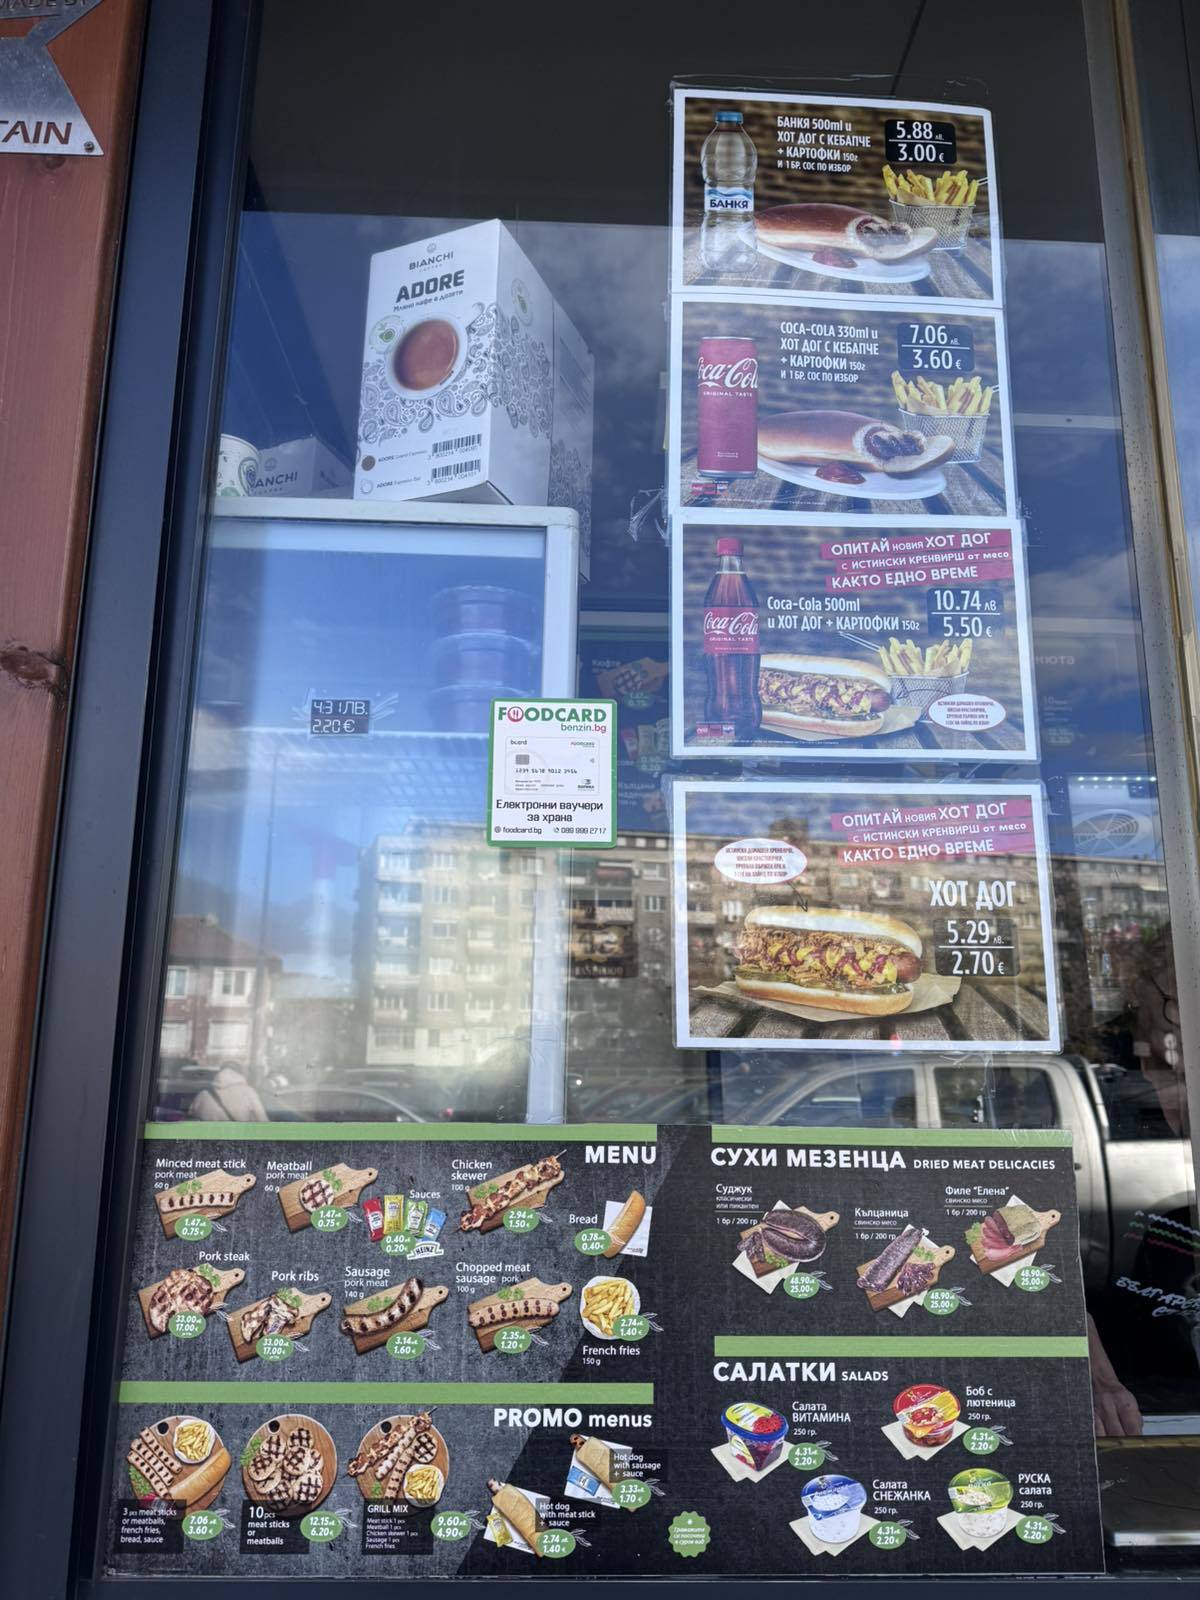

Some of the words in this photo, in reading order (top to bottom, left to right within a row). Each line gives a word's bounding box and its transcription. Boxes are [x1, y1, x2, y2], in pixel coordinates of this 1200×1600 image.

[777, 116, 810, 129] БАНКЯ
[812, 118, 843, 131] 500ml
[0, 121, 73, 146] AIN
[896, 121, 933, 140] 5.88
[777, 131, 796, 143] ХОТ
[798, 132, 817, 146] ДОГ
[819, 133, 826, 145] С
[827, 134, 871, 148] КЕБАПЧЕ
[786, 147, 841, 161] КАРТОФКИ
[898, 143, 937, 162] 3.00
[803, 161, 816, 171] СОС
[817, 162, 827, 172] ПО
[828, 163, 852, 173] ИЗБОР
[710, 199, 749, 209] БАНКЯ
[408, 251, 454, 271] BIANCHI
[396, 269, 465, 304] ADORE
[780, 322, 836, 338] COCA-COLA
[837, 325, 869, 339] 330ml
[910, 324, 948, 345] 7.06
[780, 338, 799, 351] ХОТ
[802, 339, 822, 353] ДОГ
[824, 340, 831, 353] С
[832, 341, 880, 356] КЕБАПЧЕ
[790, 355, 847, 371] КАРТОФКИ
[912, 349, 953, 370] 3.60
[955, 359, 963, 371] €
[807, 371, 821, 381] СОС
[822, 372, 833, 382] ПО
[834, 373, 859, 384] ИЗБОР
[831, 538, 890, 557] ОПИТАЙ
[925, 535, 955, 550] ХОТ
[961, 532, 991, 548] ДОГ
[852, 557, 907, 570] ИСТИНСКИ
[908, 552, 965, 567] КРЕНВИРШ
[832, 572, 881, 589] КАКТО
[886, 567, 927, 587] ЕДНО
[930, 564, 979, 582] ВРЕМЕ
[767, 596, 823, 611] Coca-Cola
[825, 597, 861, 612] 500ml
[934, 590, 982, 611] 10.74
[704, 611, 760, 636] Coca-Cola
[778, 615, 799, 630] ХОТ
[801, 616, 824, 632] ДОГ
[836, 615, 900, 632] КАРТОФКИ
[943, 616, 983, 638] 5.50
[986, 626, 993, 638] €
[498, 706, 607, 723] FOODCARD
[560, 723, 607, 734] benzin.bg
[496, 798, 558, 812] Електронни
[560, 800, 604, 813] ваучери
[527, 814, 540, 823] за
[542, 814, 573, 826] храна
[842, 808, 903, 828] ОПИТАЙ
[938, 806, 970, 821] ХОТ
[976, 802, 1007, 819] ДОГ
[502, 826, 543, 836] foodcard.bg
[864, 830, 920, 843] ИСТИНСКИ
[922, 824, 980, 839] КРЕНВИРШ
[843, 846, 894, 863] КАКТО
[898, 844, 941, 861] ЕДНО
[946, 840, 995, 856] ВРЕМЕ
[928, 880, 969, 907] ХОТ
[976, 880, 1017, 911] ДОГ
[947, 920, 990, 945] 5.29
[952, 950, 995, 976] 2.70
[997, 961, 1005, 975] €
[585, 1145, 657, 1165] MENU
[710, 1147, 778, 1168] СУХИ
[786, 1148, 907, 1173] МЕЗЕНЦА
[156, 1158, 193, 1169] Minced
[195, 1160, 222, 1170] meat
[223, 1159, 247, 1170] stick
[266, 1161, 313, 1172] Meatball
[452, 1159, 493, 1170] Chicken
[913, 1159, 950, 1170] DRIED
[952, 1159, 986, 1170] MEAT
[988, 1160, 1057, 1171] DELICACIES
[154, 1172, 174, 1181] pork
[266, 1172, 288, 1181] pork
[451, 1170, 488, 1181] skewer
[409, 1189, 441, 1199] Sauces
[716, 1184, 753, 1196] Суджук
[945, 1186, 972, 1197] Филе
[854, 1208, 909, 1221] Кълцаница
[966, 1208, 979, 1218] 200
[569, 1214, 599, 1225] Bread
[386, 1234, 405, 1244] 0.40
[876, 1232, 889, 1241] 200
[199, 1251, 223, 1262] Pork
[224, 1251, 251, 1262] steak
[344, 1266, 391, 1280] Sausage
[456, 1262, 503, 1275] Chopped
[504, 1263, 532, 1273] meat
[272, 1270, 297, 1282] Pork
[298, 1270, 320, 1283] ribs
[456, 1274, 497, 1286] sausage
[501, 1274, 520, 1285] pork
[344, 1278, 366, 1289] pork
[366, 1278, 390, 1288] meat
[344, 1291, 358, 1299] 140
[394, 1346, 412, 1355] 1.60
[582, 1345, 617, 1356] French
[618, 1345, 641, 1356] fries
[582, 1357, 595, 1366] 150
[713, 1362, 836, 1383] САЛАТКИ
[842, 1370, 889, 1382] SALADS
[966, 1386, 986, 1397] Боб
[792, 1401, 827, 1412] Салата
[966, 1399, 1017, 1409] лютеница
[494, 1408, 583, 1429] PROMO
[588, 1412, 653, 1429] menus
[792, 1412, 852, 1423] ВИТАМИНА
[794, 1428, 807, 1436] 250
[614, 1454, 630, 1462] Hot
[628, 1454, 644, 1463] dog
[614, 1462, 631, 1470] with
[632, 1462, 662, 1471] sausage
[872, 1479, 908, 1490] Салата
[1018, 1474, 1051, 1485] РУСКА
[872, 1491, 932, 1502] СНЕЖАНКА
[1018, 1486, 1053, 1497] салата
[248, 1506, 265, 1519] 10
[367, 1504, 391, 1514] GRILL
[392, 1504, 410, 1514] MIX
[540, 1502, 555, 1511] Hot
[554, 1502, 571, 1512] dog
[874, 1506, 888, 1515] 250
[190, 1515, 209, 1525] 7.06
[558, 1512, 578, 1520] meat
[578, 1510, 596, 1520] stick
[248, 1520, 268, 1529] meat
[269, 1520, 291, 1529] sticks
[438, 1516, 460, 1527] 9.60
[548, 1520, 571, 1528] sauce
[120, 1526, 144, 1535] french
[188, 1525, 208, 1536] 3.60
[436, 1528, 460, 1538] 4.90
[144, 1536, 164, 1544] sauce
[246, 1536, 285, 1546] meatballs
